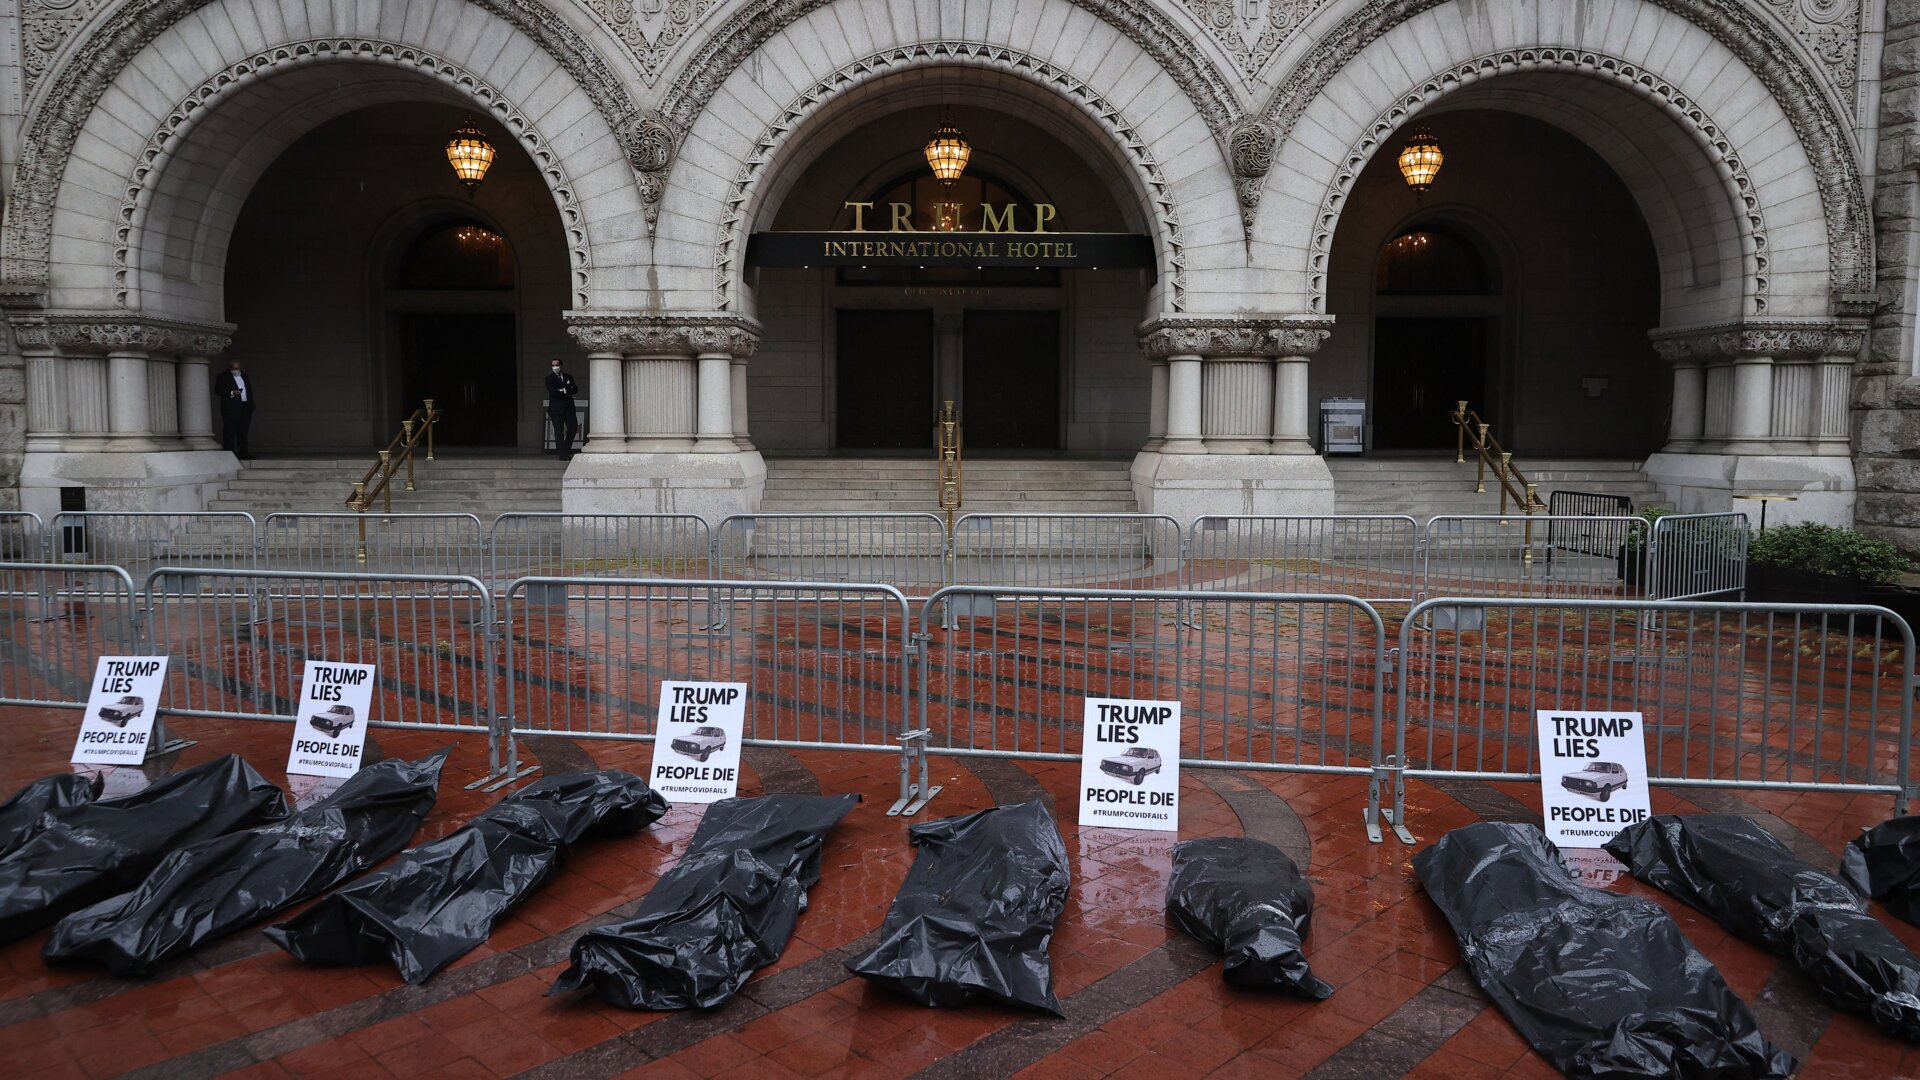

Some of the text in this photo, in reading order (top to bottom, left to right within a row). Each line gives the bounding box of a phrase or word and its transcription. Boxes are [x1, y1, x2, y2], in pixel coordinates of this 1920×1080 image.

[844, 201, 1056, 232] TRUMP
[823, 241, 1078, 258] INTERNATIONAL HOTEL
[107, 661, 160, 677] TRUMP
[314, 666, 368, 685] TRUMP
[101, 678, 133, 693] LIES
[310, 684, 342, 702] LIES
[672, 687, 739, 705] TRUMP
[670, 705, 708, 724] LIES
[1097, 704, 1172, 725] TRUMP
[1096, 724, 1139, 744] LIES
[1551, 717, 1633, 738] TRUMP
[82, 731, 147, 744] PEOPLE DIE
[296, 740, 360, 757] PEOPLE DIE
[1553, 738, 1600, 758] LIES
[298, 759, 353, 769] #TRUMPCOVIDFAILS
[656, 765, 735, 781] PEOPLE DIE
[660, 785, 728, 794] #TRUMPCOVIDFAILS
[1086, 788, 1175, 807] PEOPLE DIE
[1092, 809, 1169, 820] #TRUMPCOVIDFAILS
[1550, 806, 1616, 823] PEOPLE
[1560, 829, 1620, 837] #TRUMPCOVID
